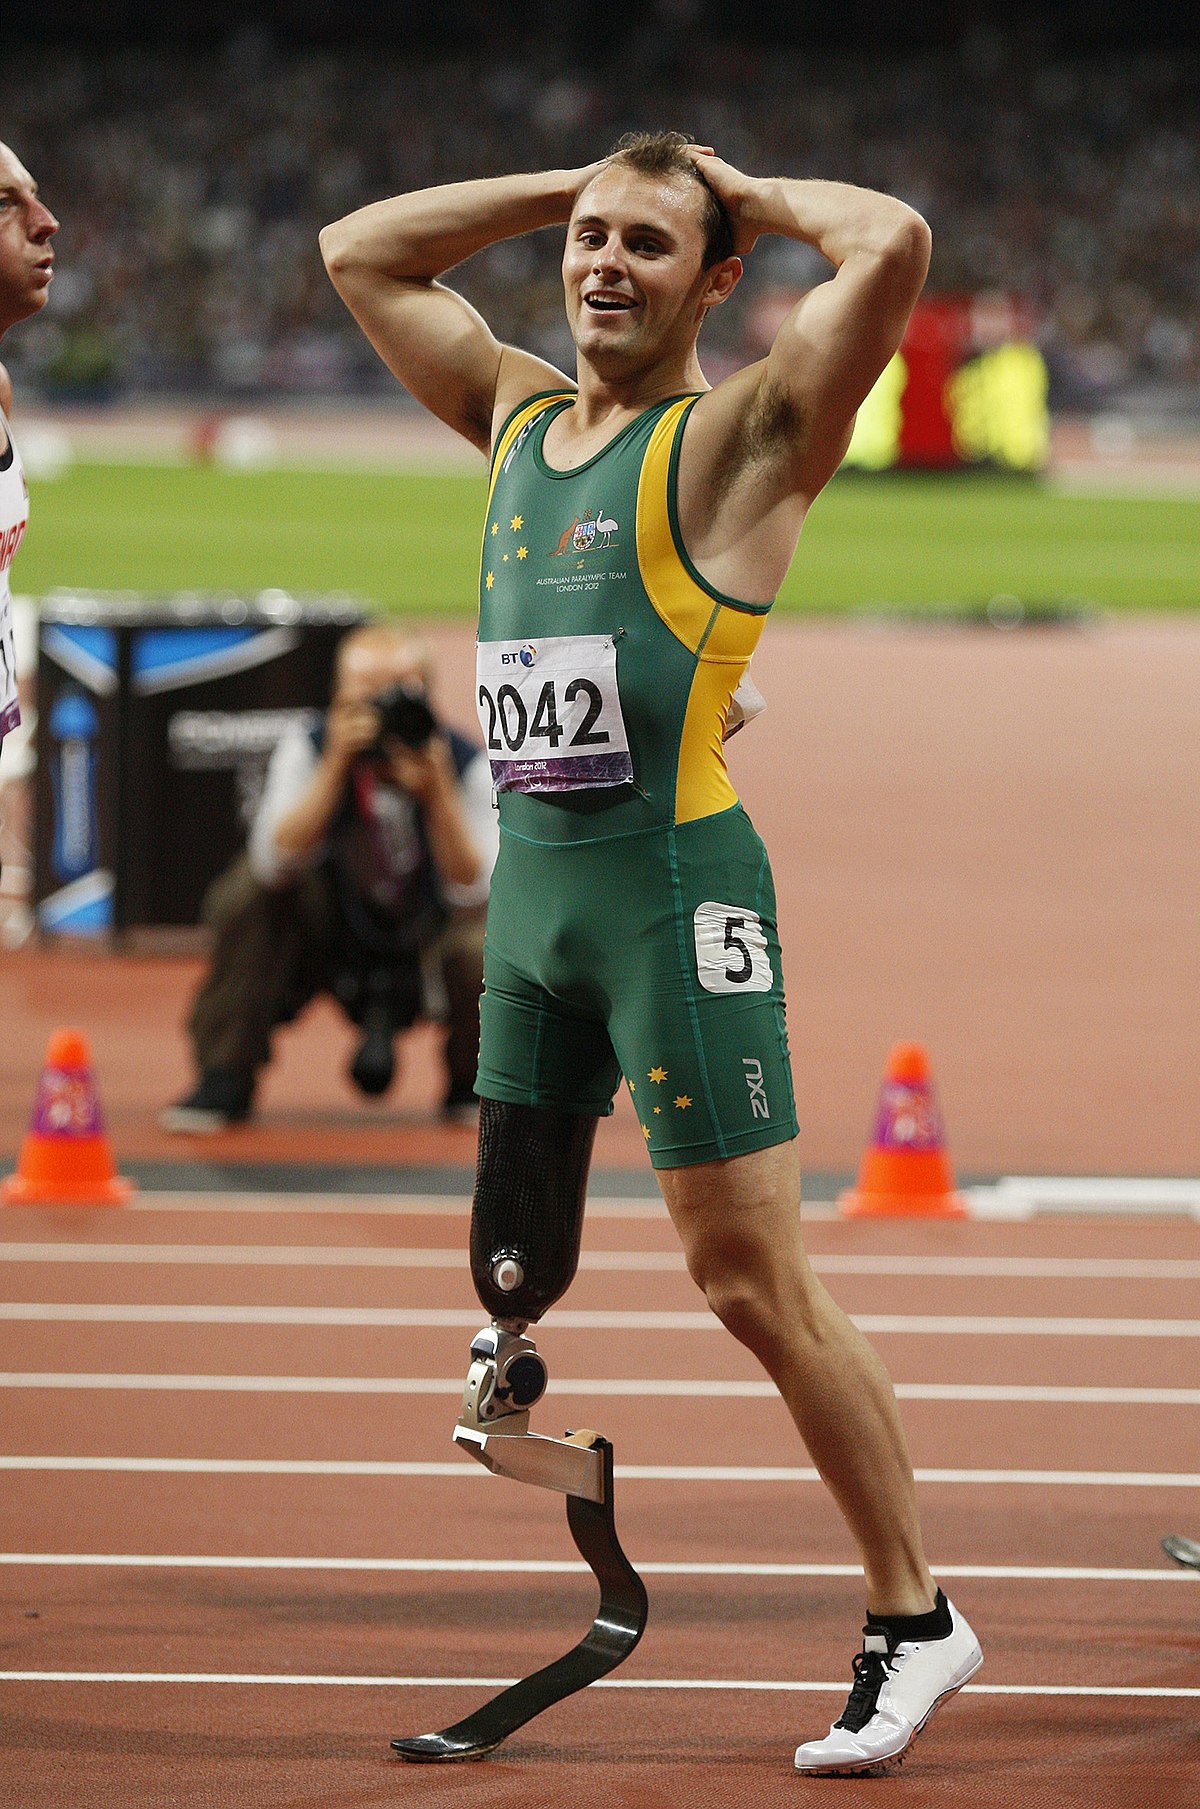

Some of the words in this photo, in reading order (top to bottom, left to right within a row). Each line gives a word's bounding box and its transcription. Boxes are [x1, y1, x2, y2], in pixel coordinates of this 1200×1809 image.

[536, 577, 570, 585] AUSTRALIAN
[571, 572, 606, 583] PARALYMPIC
[608, 572, 627, 580] TEAM
[556, 584, 583, 593] LONDON
[584, 582, 599, 591] 2012
[501, 652, 518, 665] BT
[479, 677, 610, 752] 2042
[724, 916, 752, 984] 5
[742, 1058, 770, 1119] 2XU
